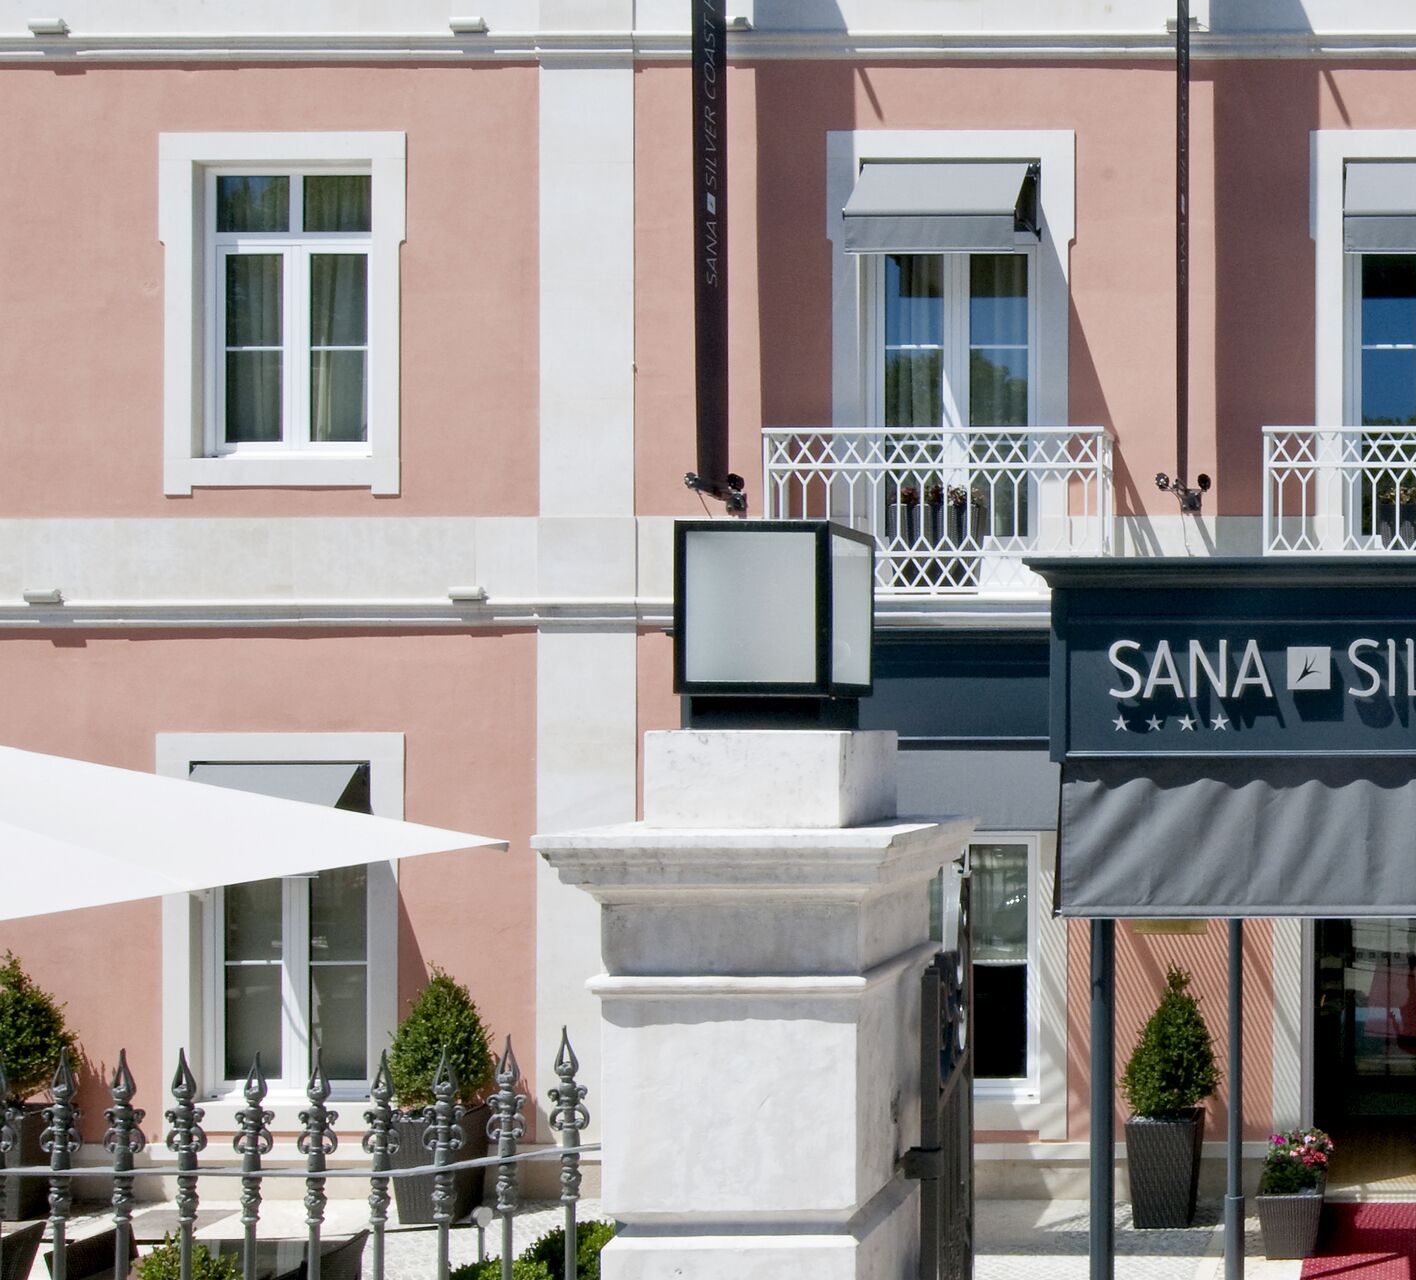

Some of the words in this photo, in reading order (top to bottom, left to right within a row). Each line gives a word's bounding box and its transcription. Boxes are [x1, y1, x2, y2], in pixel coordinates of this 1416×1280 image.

[704, 12, 717, 99] COAST
[705, 105, 717, 189] SILVER
[706, 220, 718, 287] SANA
[1108, 639, 1273, 699] SANA
